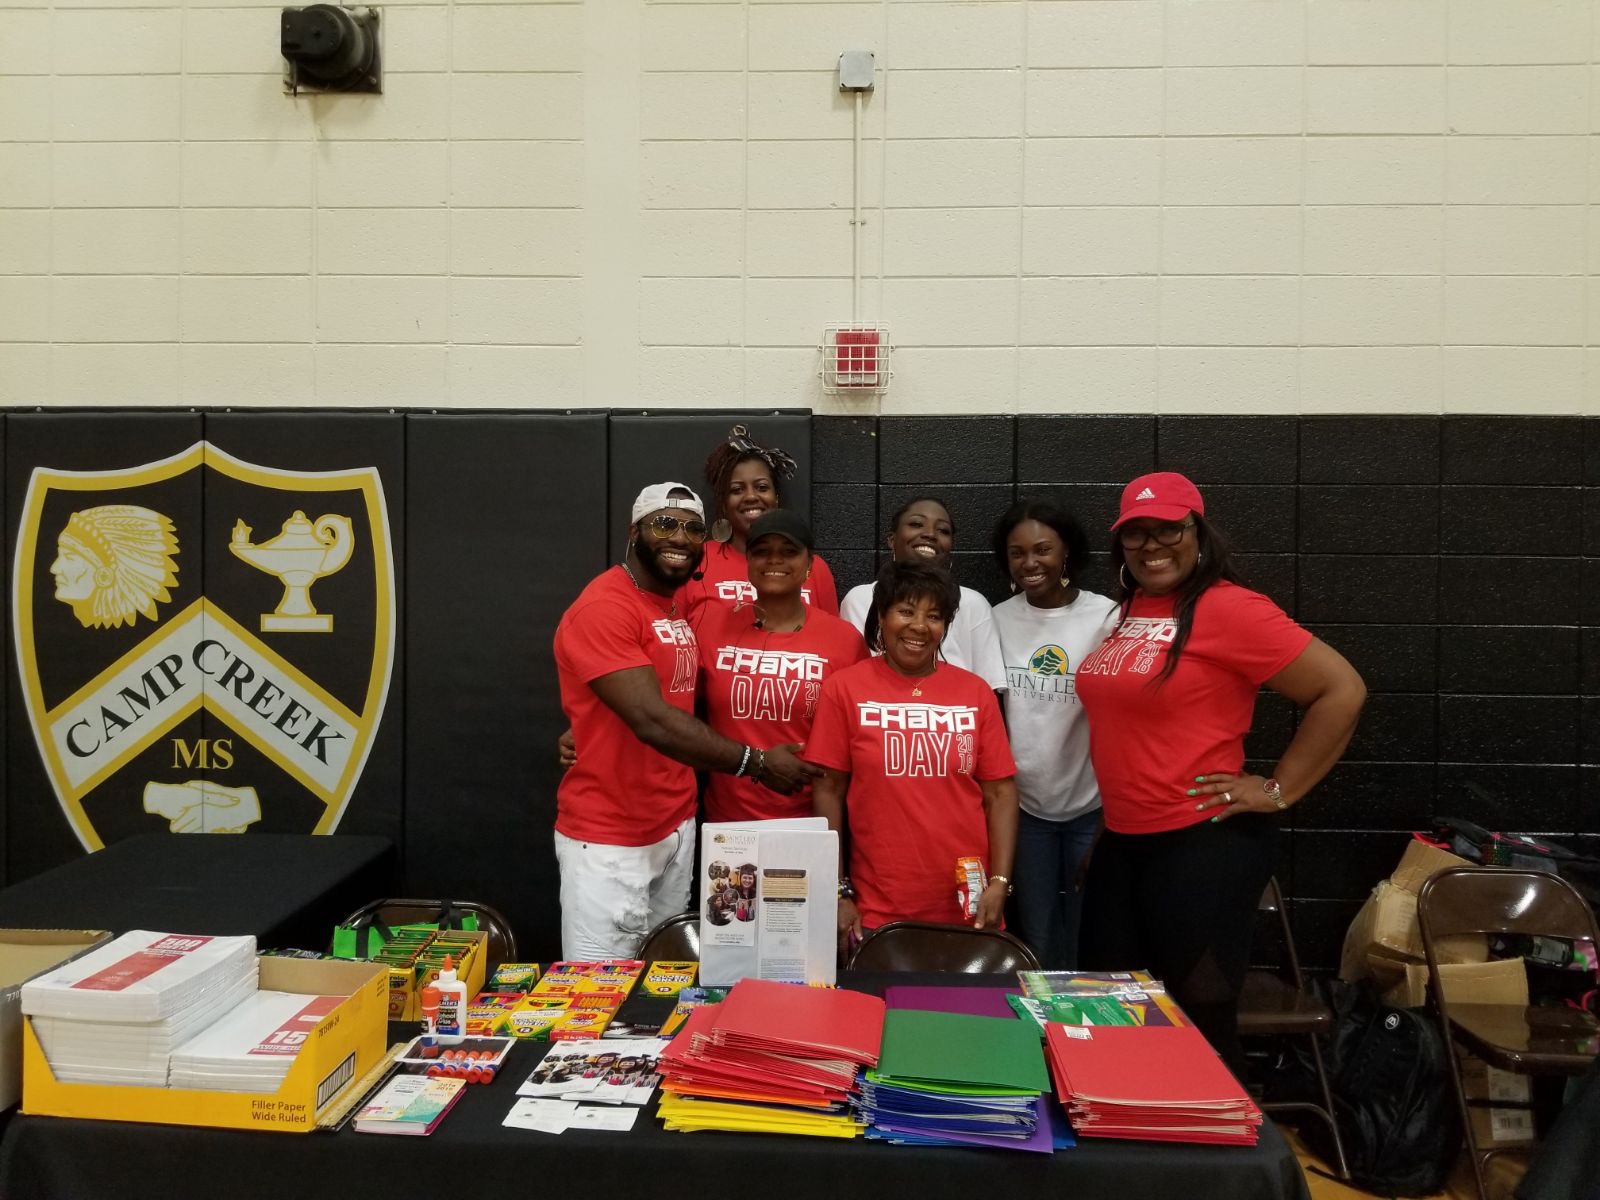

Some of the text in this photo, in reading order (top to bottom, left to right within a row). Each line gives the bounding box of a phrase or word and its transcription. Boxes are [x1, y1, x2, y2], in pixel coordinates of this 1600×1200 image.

[1079, 639, 1145, 676] DAY
[1128, 656, 1153, 674] 18
[1008, 672, 1076, 696] AINT LE
[66, 639, 347, 766] CAMP CREEK
[730, 675, 801, 722] DAY
[171, 738, 235, 770] MS
[884, 730, 952, 777] DAY
[956, 734, 974, 754] 20
[251, 1100, 306, 1112] Filler Paper
[252, 1111, 307, 1123] Wide Ruled
